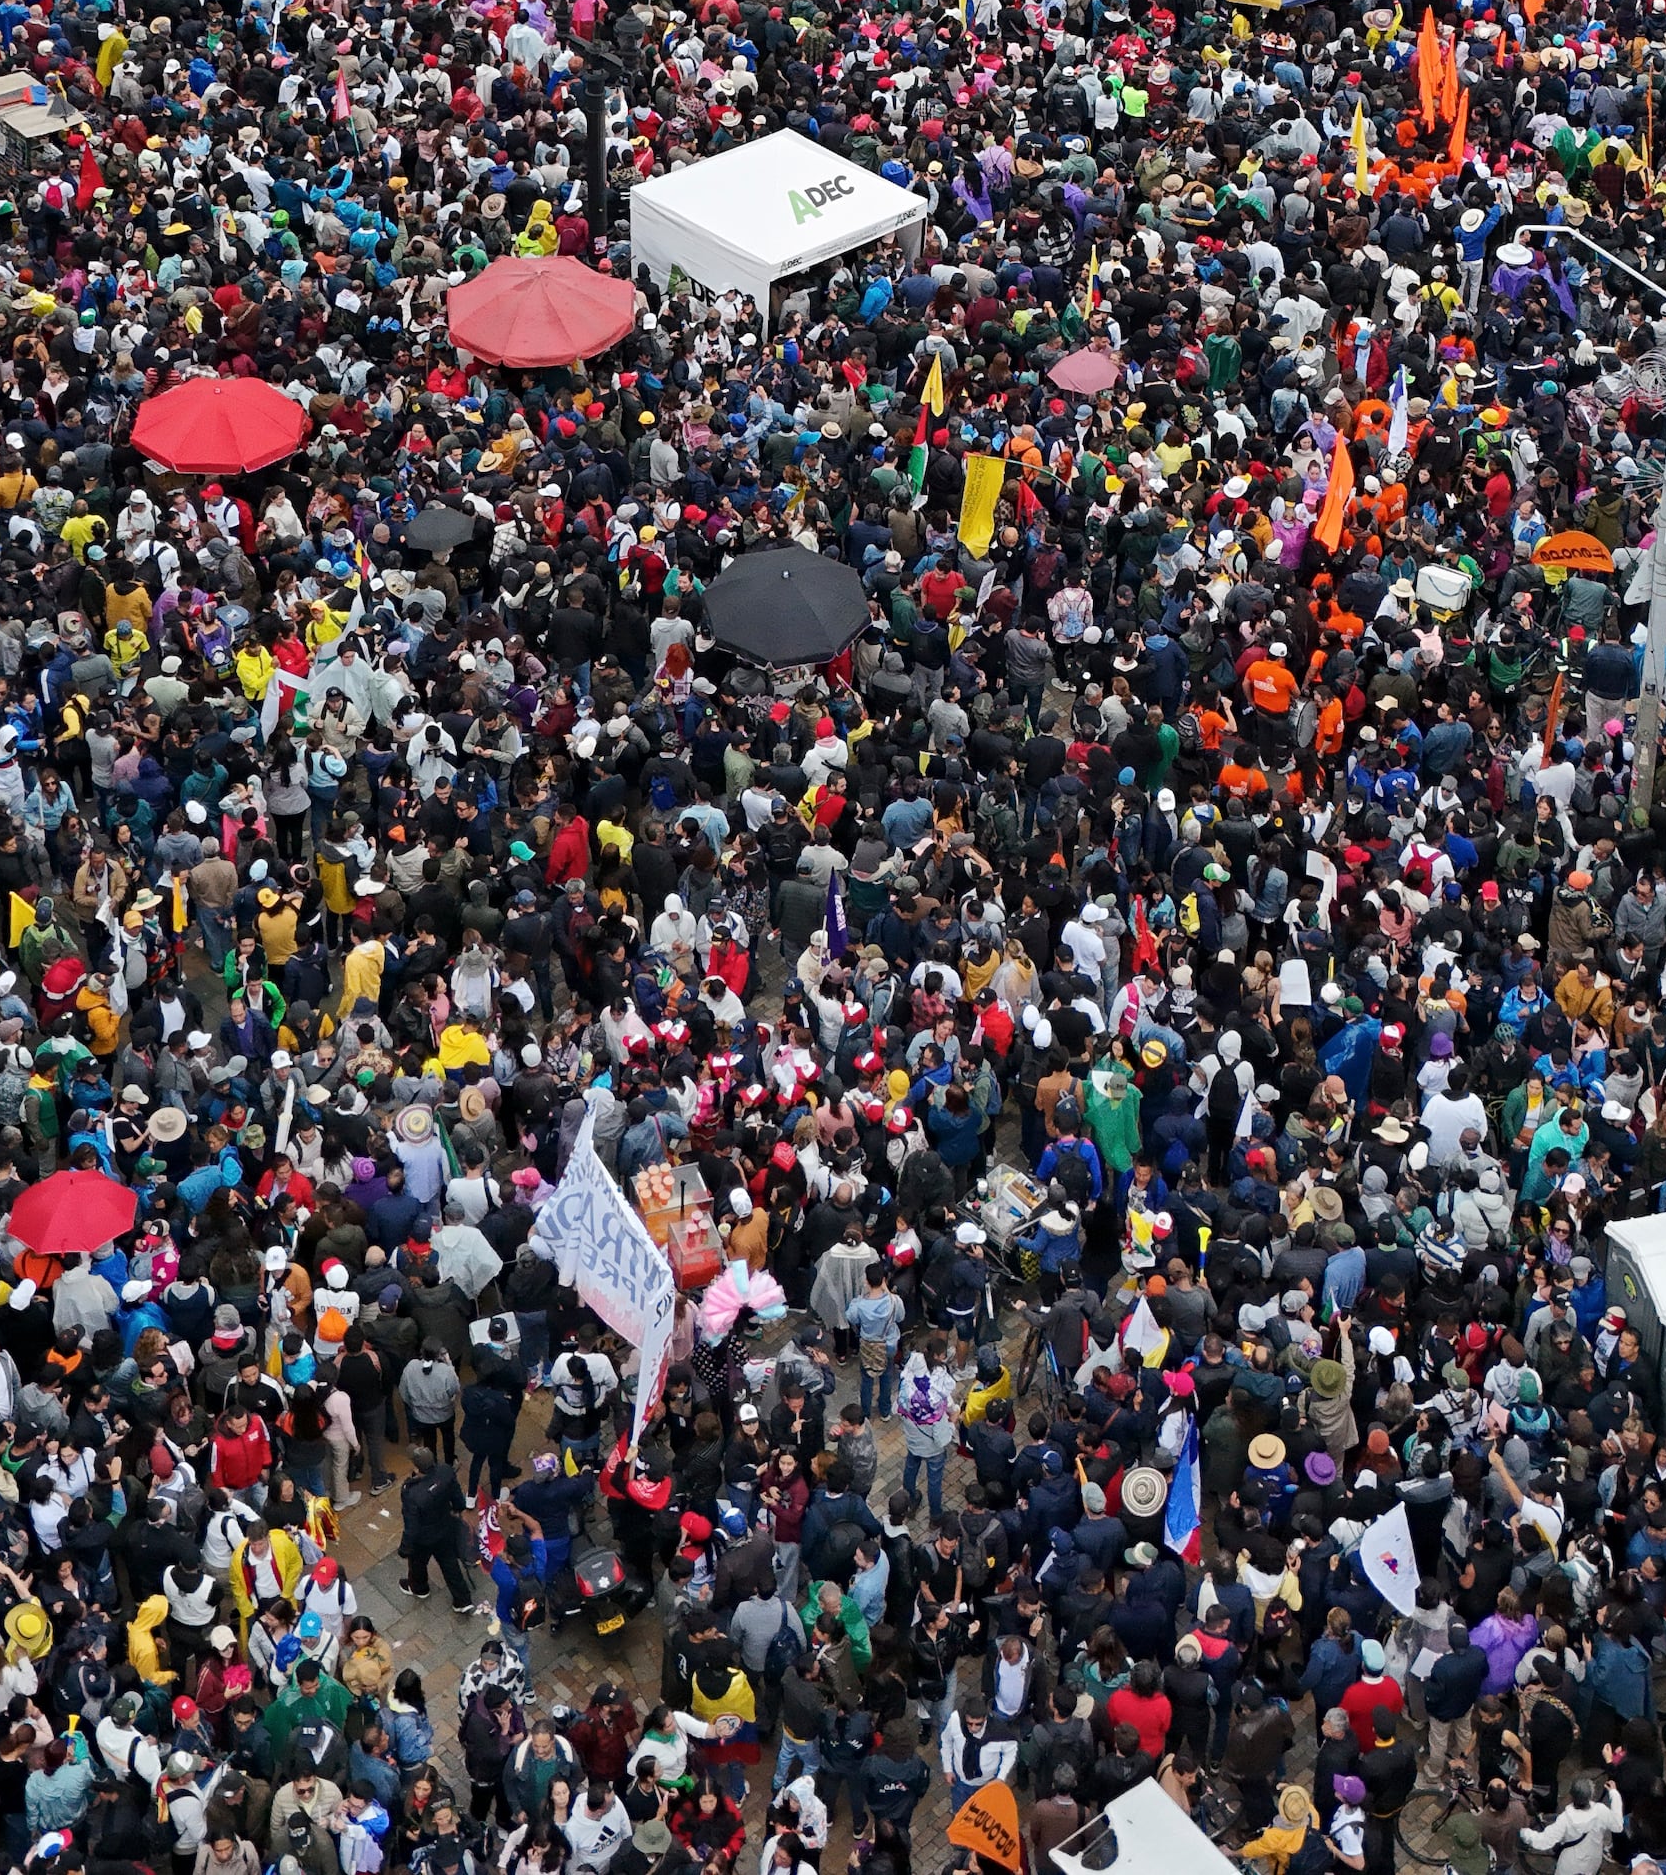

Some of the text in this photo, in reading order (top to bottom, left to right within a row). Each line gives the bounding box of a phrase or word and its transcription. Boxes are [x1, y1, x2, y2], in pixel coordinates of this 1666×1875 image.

[787, 175, 855, 225] ADEC
[894, 208, 917, 227] ADEC
[779, 256, 803, 273] ADEC
[315, 1303, 353, 1316] LOON
